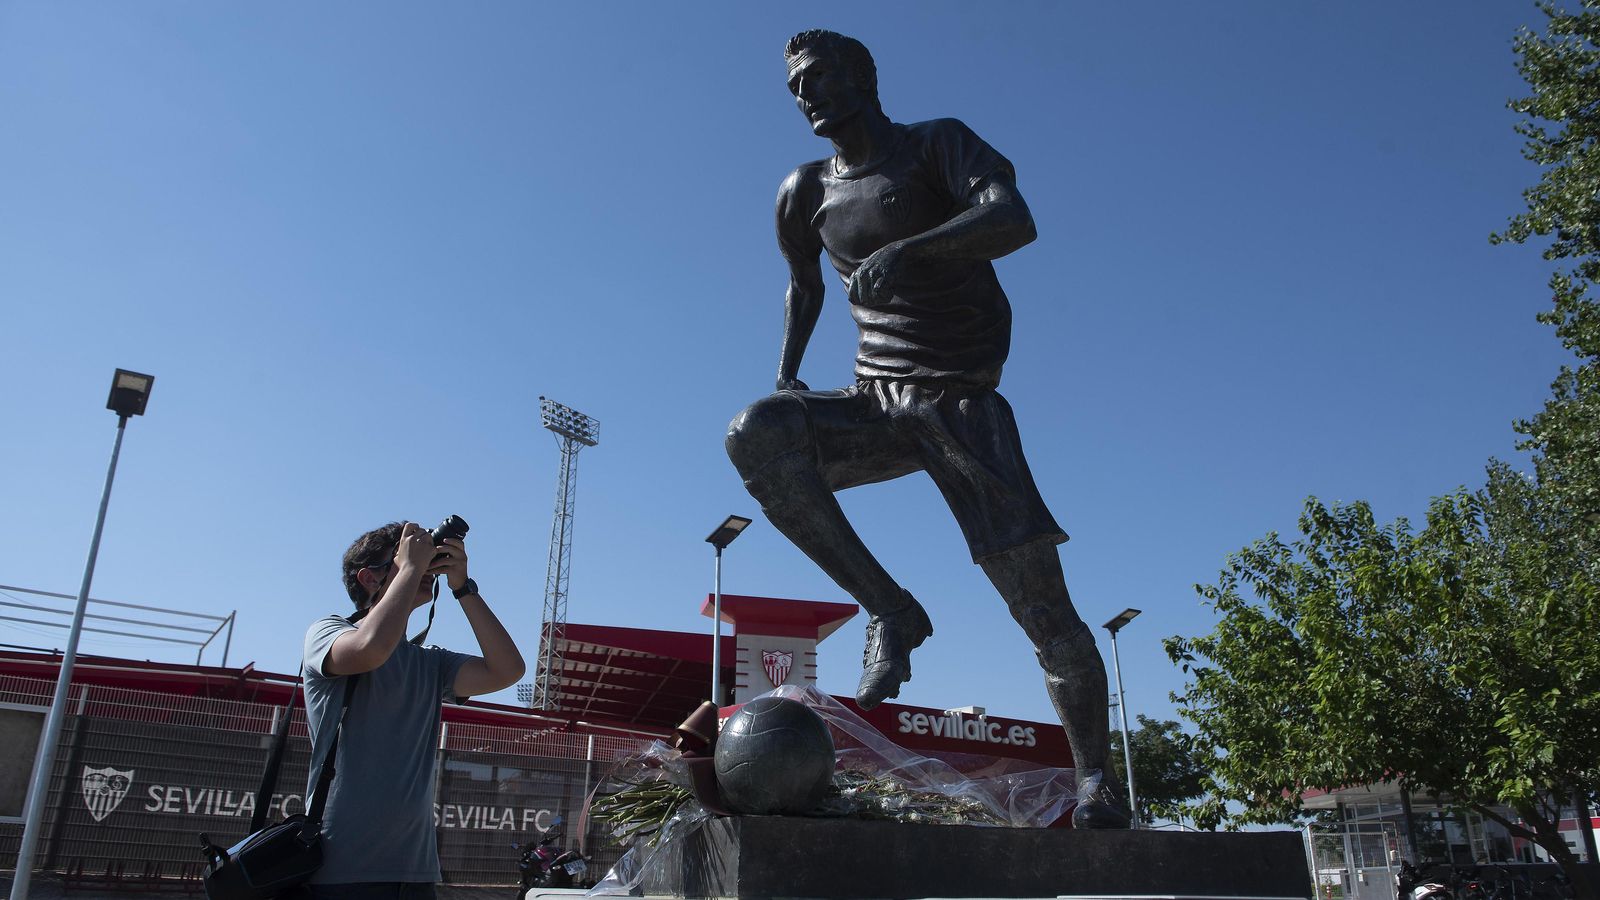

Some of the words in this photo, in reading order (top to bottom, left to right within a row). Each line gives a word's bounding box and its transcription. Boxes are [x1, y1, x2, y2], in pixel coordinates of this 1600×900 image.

[898, 710, 1037, 748] sevillafc.es
[145, 785, 256, 817] SEVILLA
[266, 793, 302, 819] FC
[522, 809, 551, 833] FC
